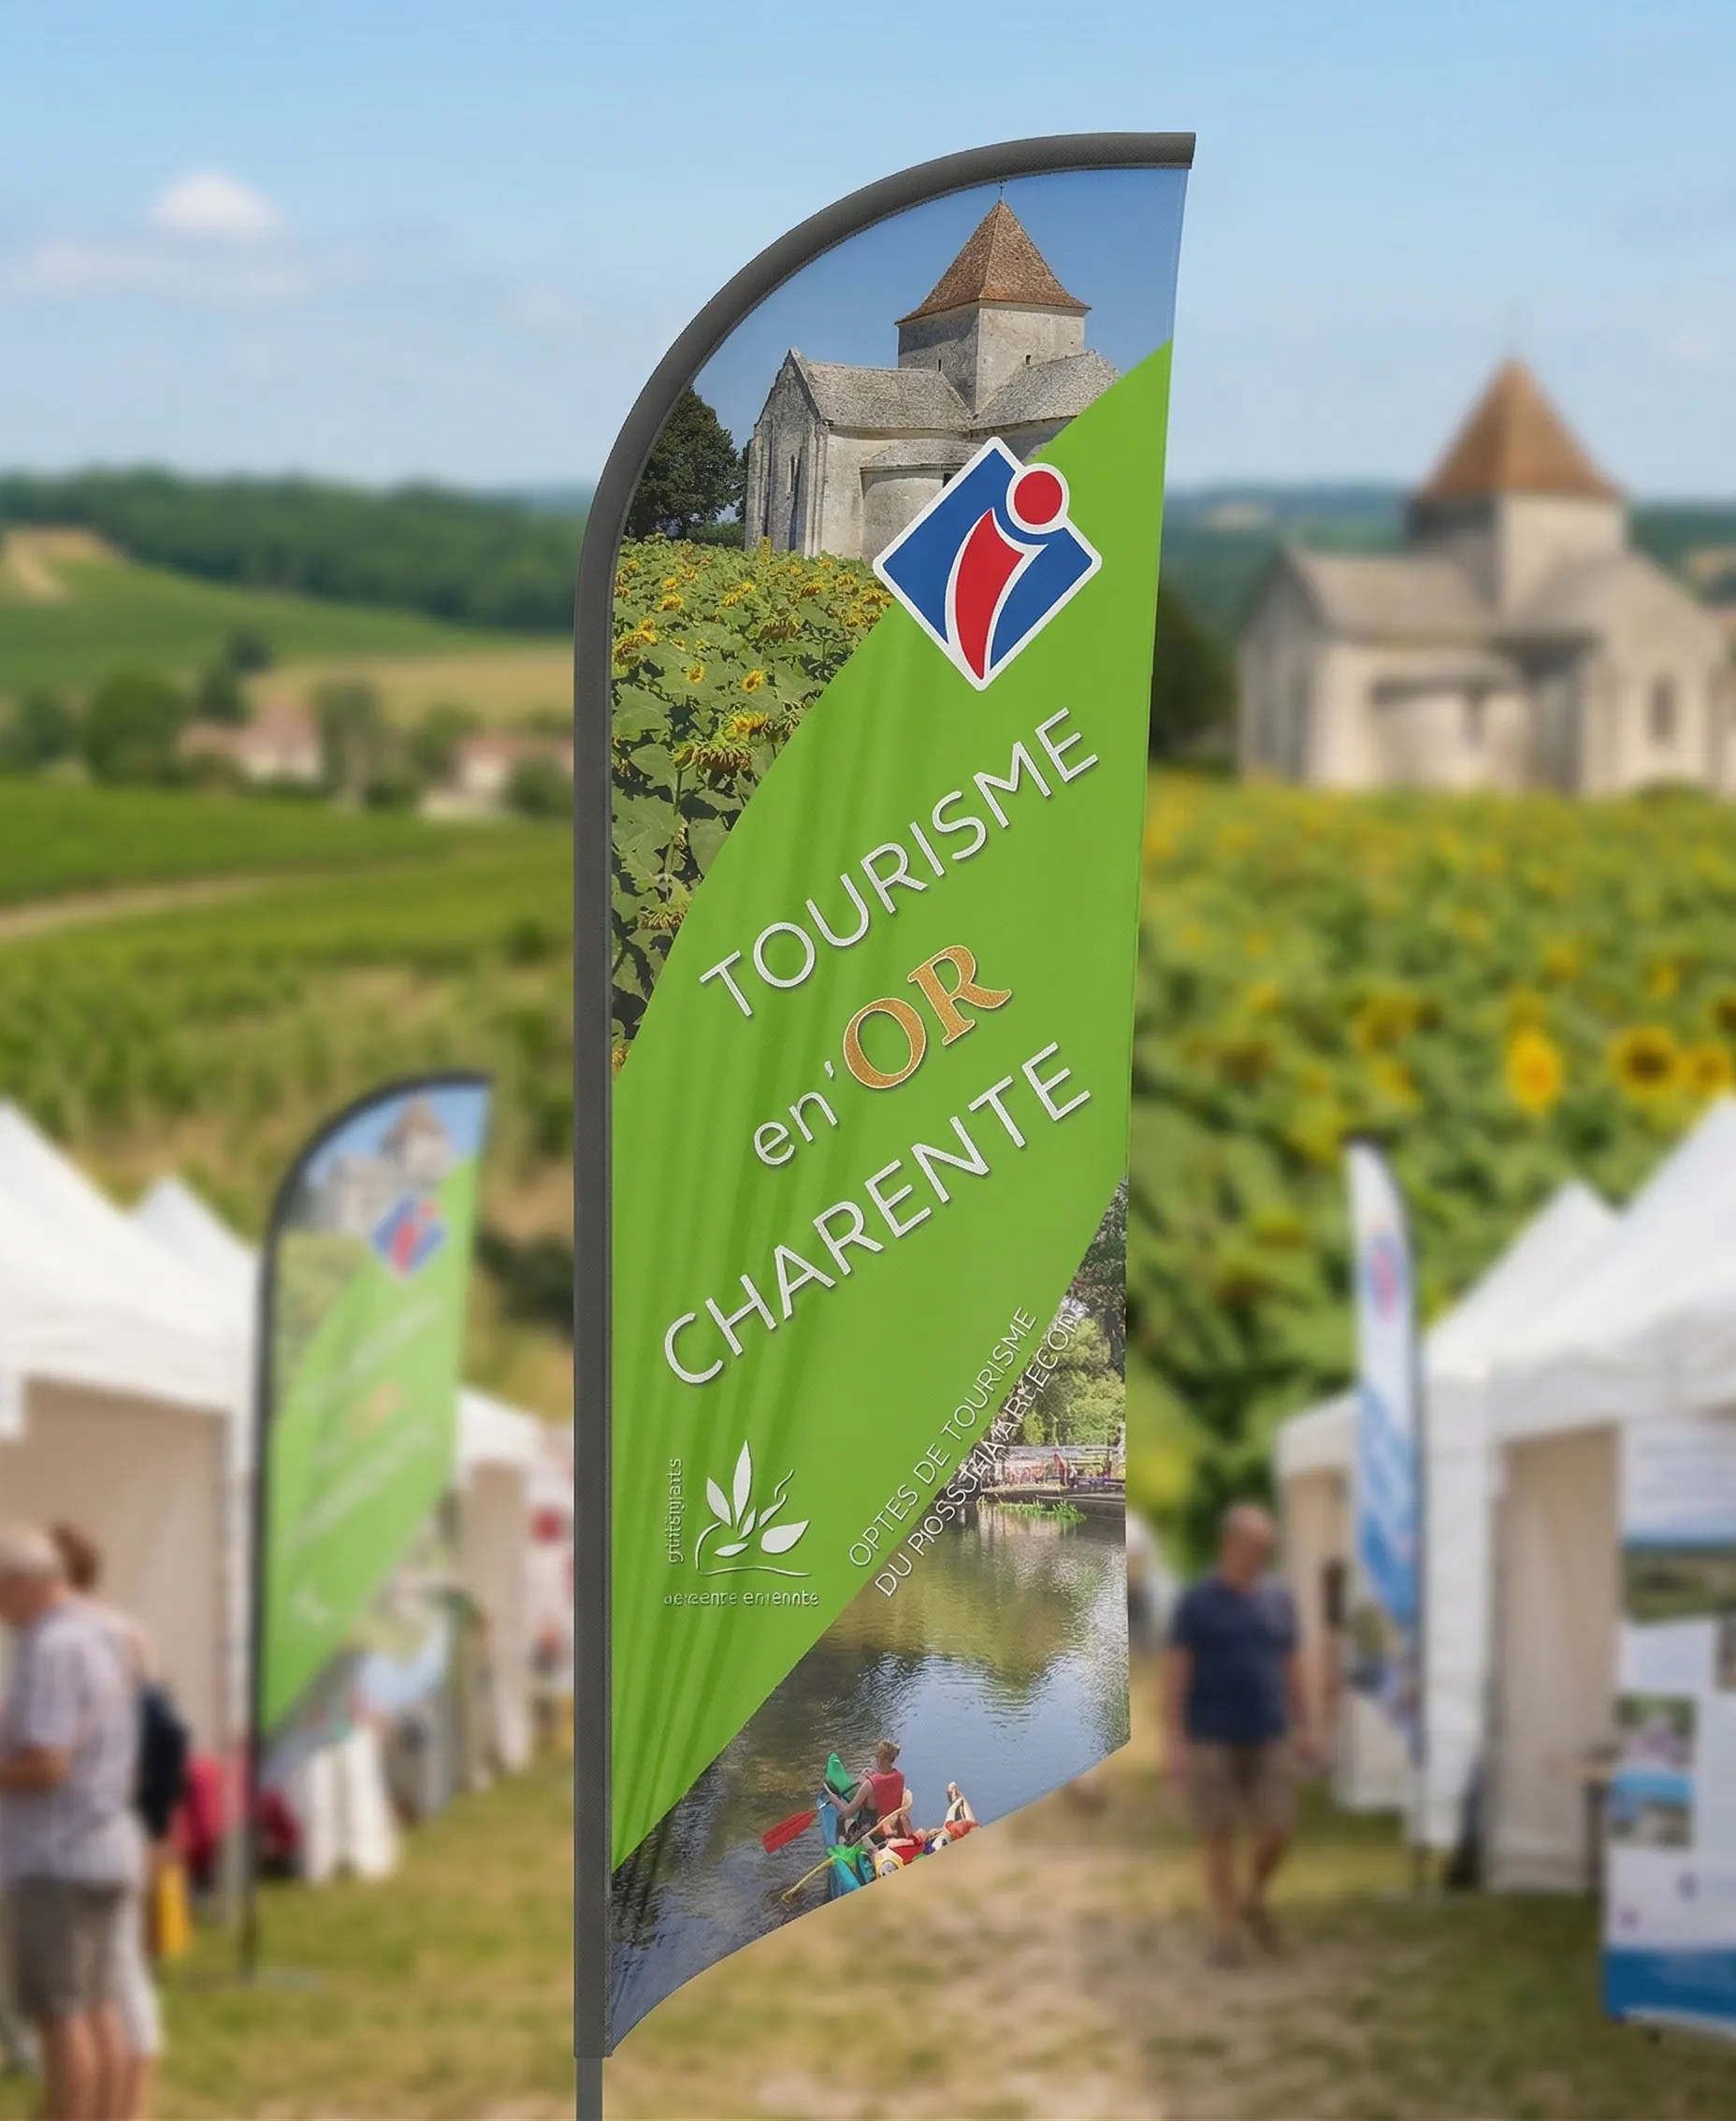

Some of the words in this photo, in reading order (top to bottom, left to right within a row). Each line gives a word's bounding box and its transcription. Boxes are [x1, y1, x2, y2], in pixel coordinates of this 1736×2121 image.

[699, 707, 1101, 1017] TOURISME
[662, 1042, 1092, 1386] CHARENTE
[848, 1484, 919, 1567] OPTES
[913, 1443, 951, 1485] DE
[940, 1306, 1037, 1442] TOURISME
[874, 1552, 914, 1598] DU
